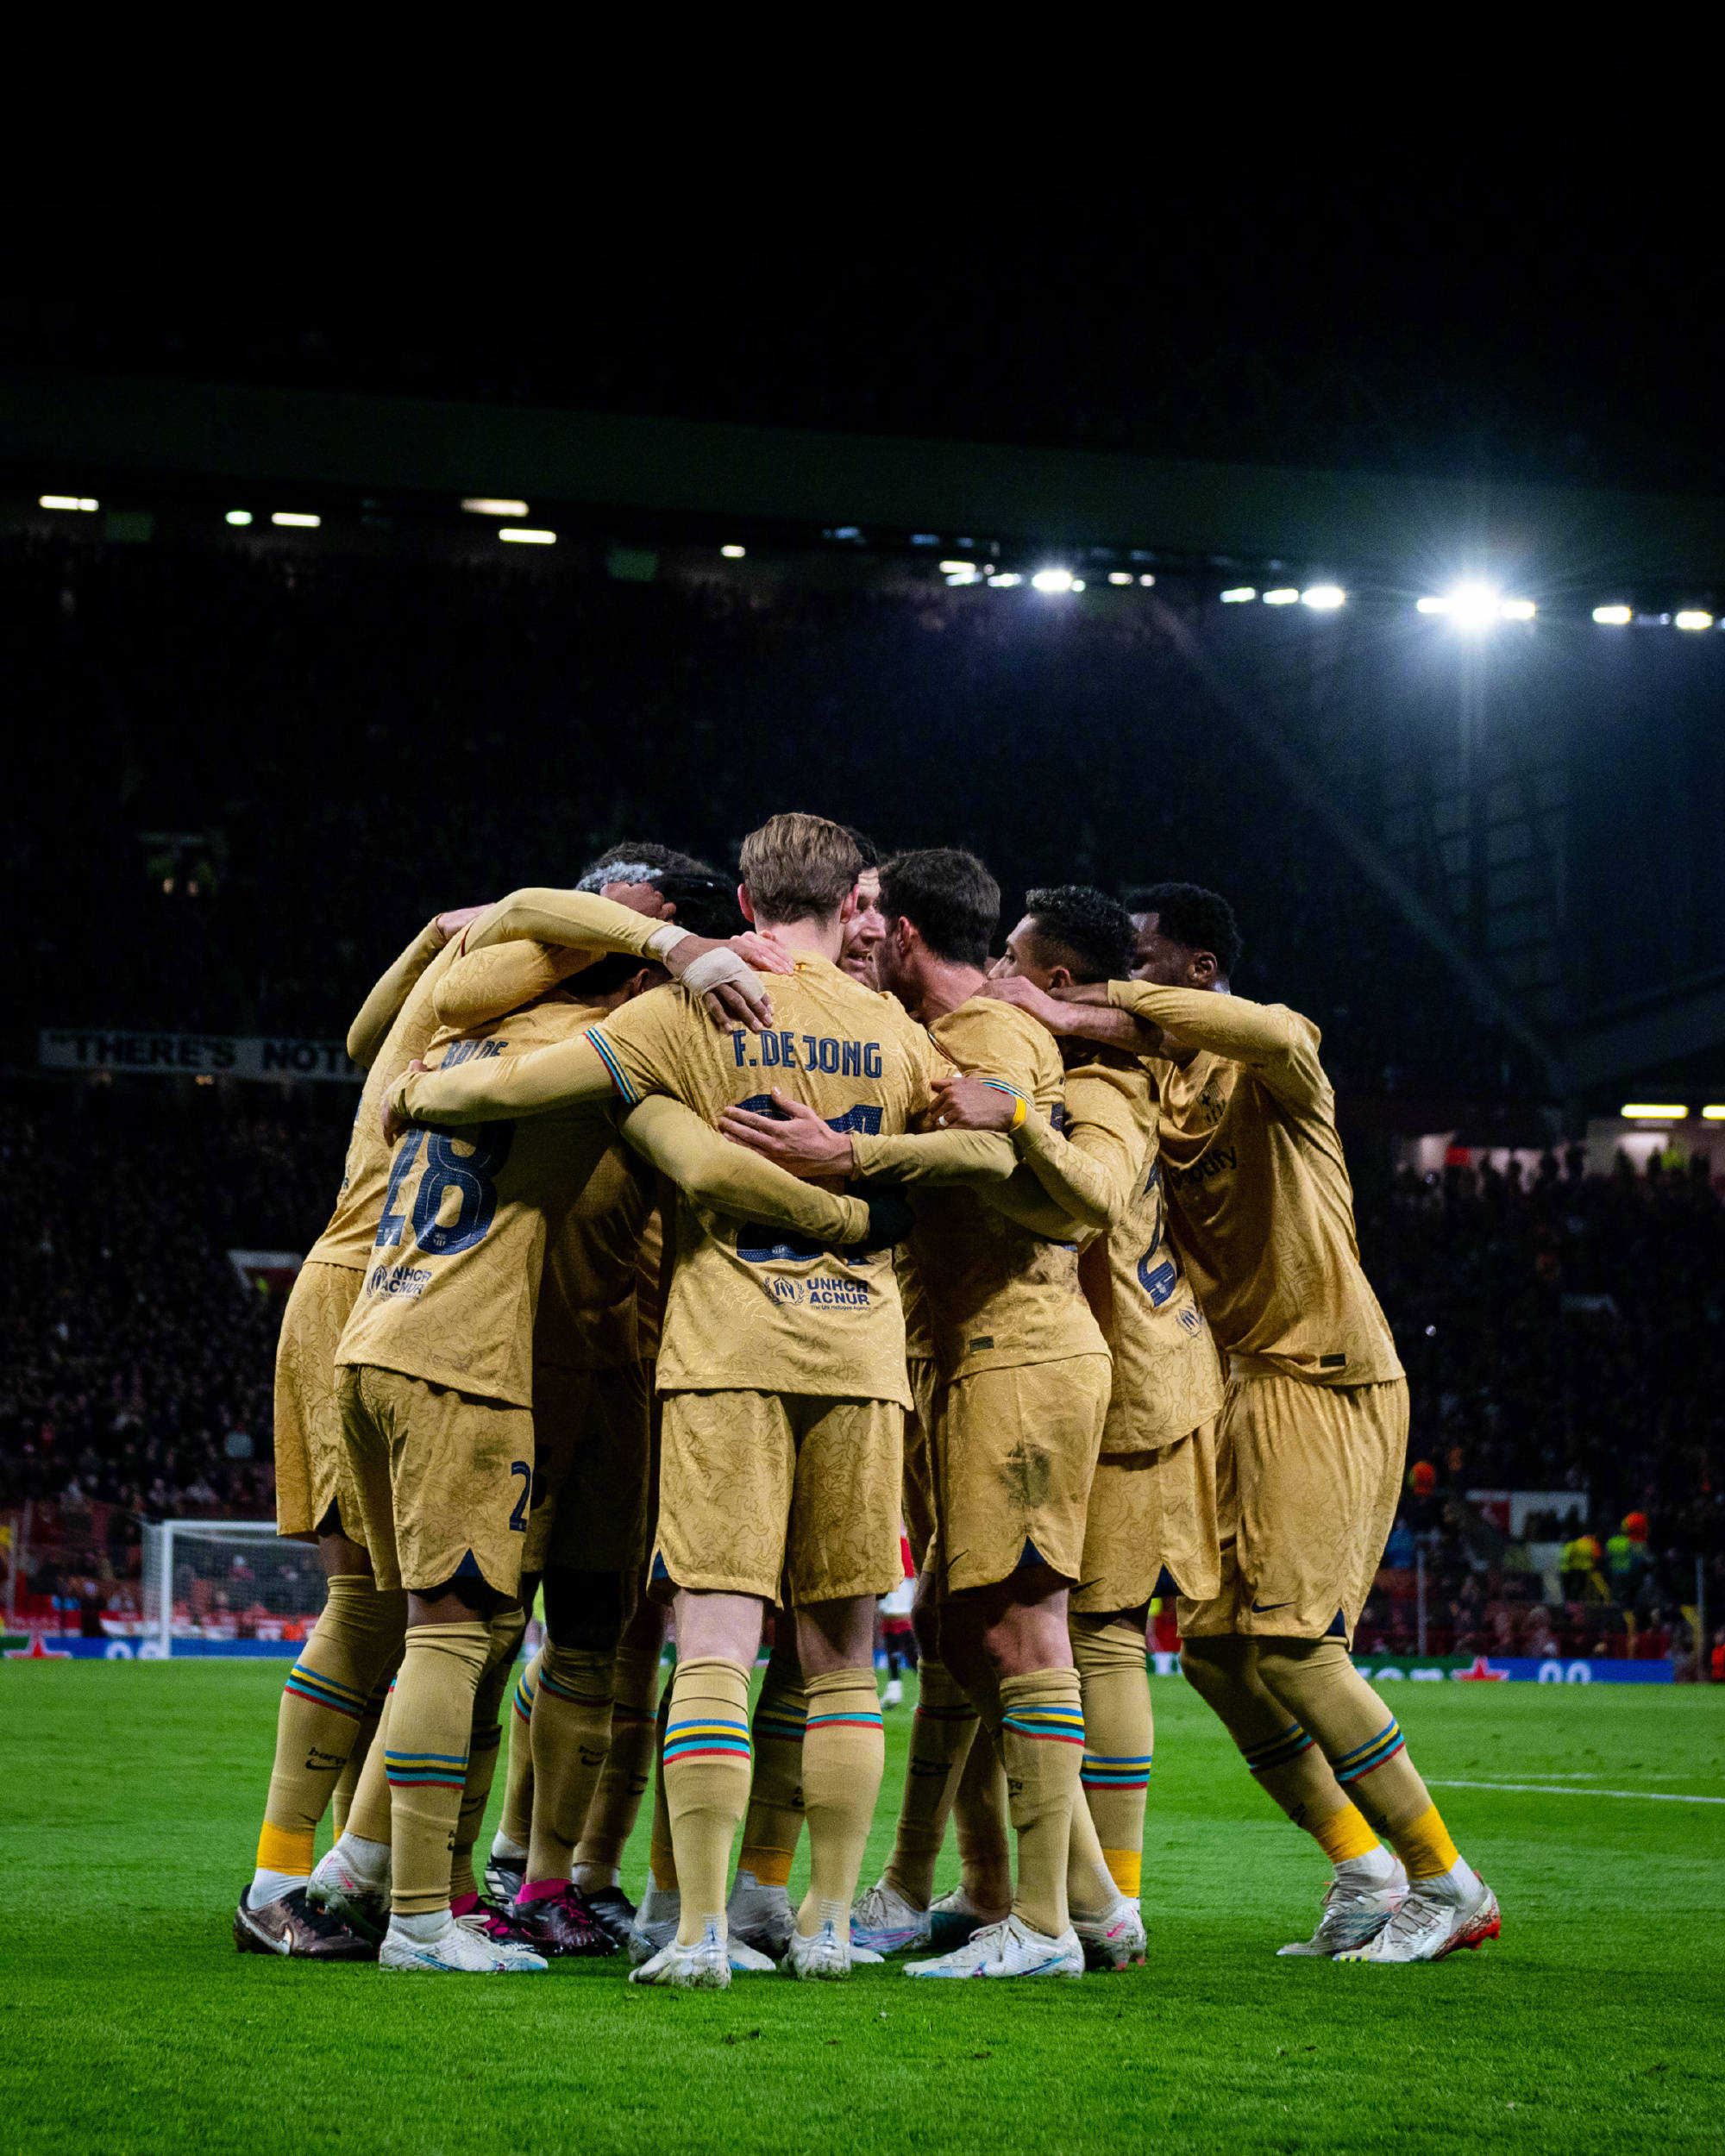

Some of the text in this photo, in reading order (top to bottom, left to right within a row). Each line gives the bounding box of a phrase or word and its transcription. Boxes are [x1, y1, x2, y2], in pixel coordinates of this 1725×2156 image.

[802, 1035, 883, 1078] JONG
[391, 1265, 432, 1282] NHCR
[806, 1277, 869, 1294] UNHCR
[810, 1292, 870, 1306] ACNUR
